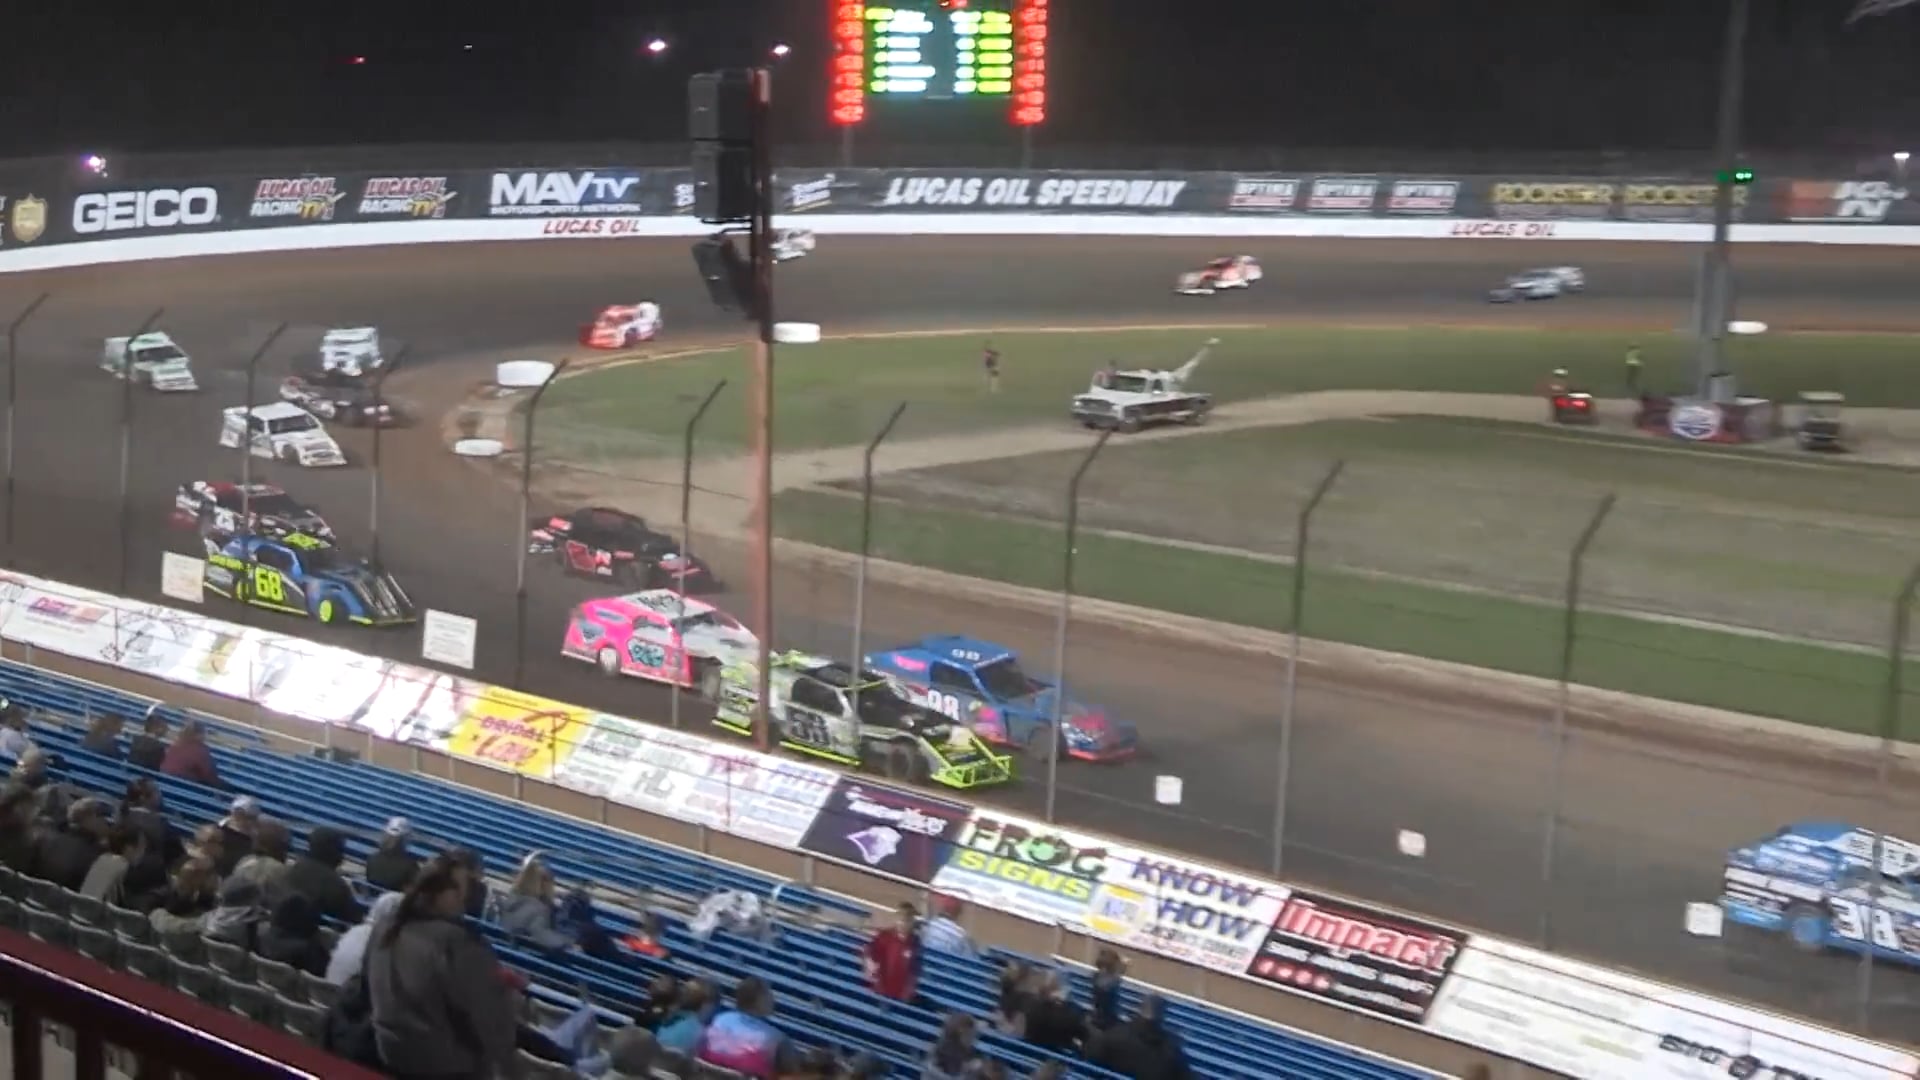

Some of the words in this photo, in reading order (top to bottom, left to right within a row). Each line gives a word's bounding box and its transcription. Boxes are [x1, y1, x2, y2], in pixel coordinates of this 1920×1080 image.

[255, 180, 310, 200] LUCAS
[365, 179, 420, 198] LUCAS
[887, 177, 982, 205] LUCAS
[984, 178, 1031, 205] OIL
[1036, 179, 1187, 207] SPEEDWAY
[73, 187, 217, 233] GEICO
[543, 219, 605, 235] LUCAS
[609, 219, 641, 233] OIL
[1452, 222, 1515, 237] LUCAS
[255, 567, 284, 601] 68
[968, 816, 1108, 880] FROG
[958, 848, 1091, 900] SIGNS
[1131, 856, 1264, 908] KNOW
[1157, 898, 1262, 941] HOW
